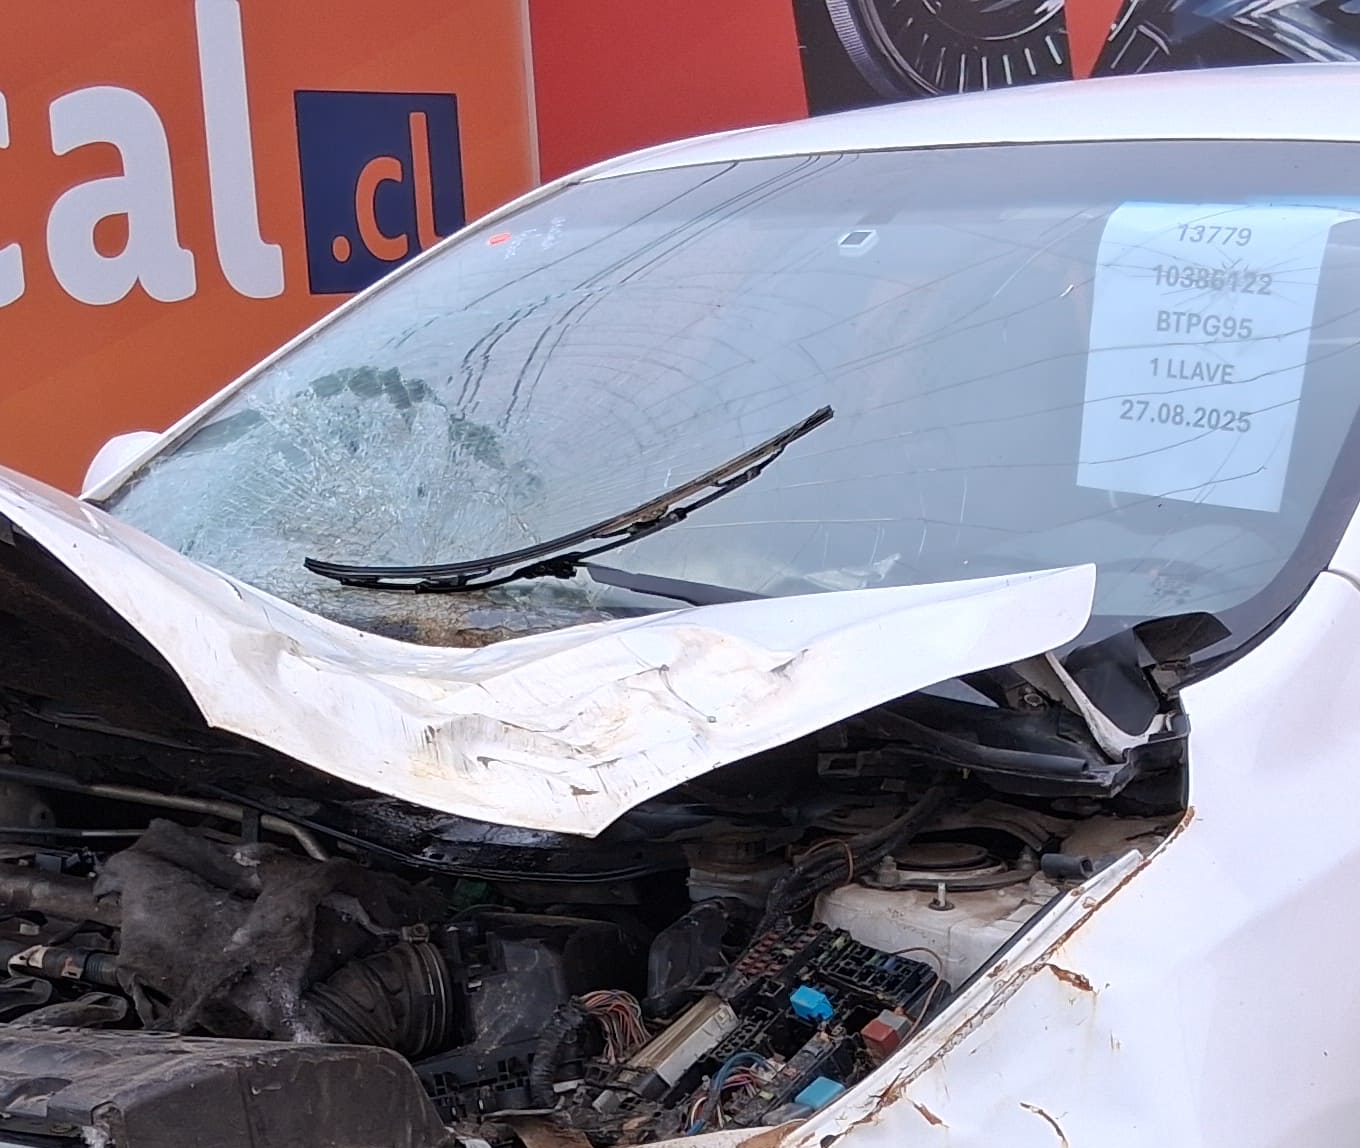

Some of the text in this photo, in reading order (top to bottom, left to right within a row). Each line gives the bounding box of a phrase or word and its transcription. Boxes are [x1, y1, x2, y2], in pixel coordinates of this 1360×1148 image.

[1177, 223, 1252, 247] 13779
[1156, 309, 1253, 339] BTPG95
[1149, 357, 1235, 384] 1 LLAVE
[1119, 398, 1251, 433] 27.08.2025
